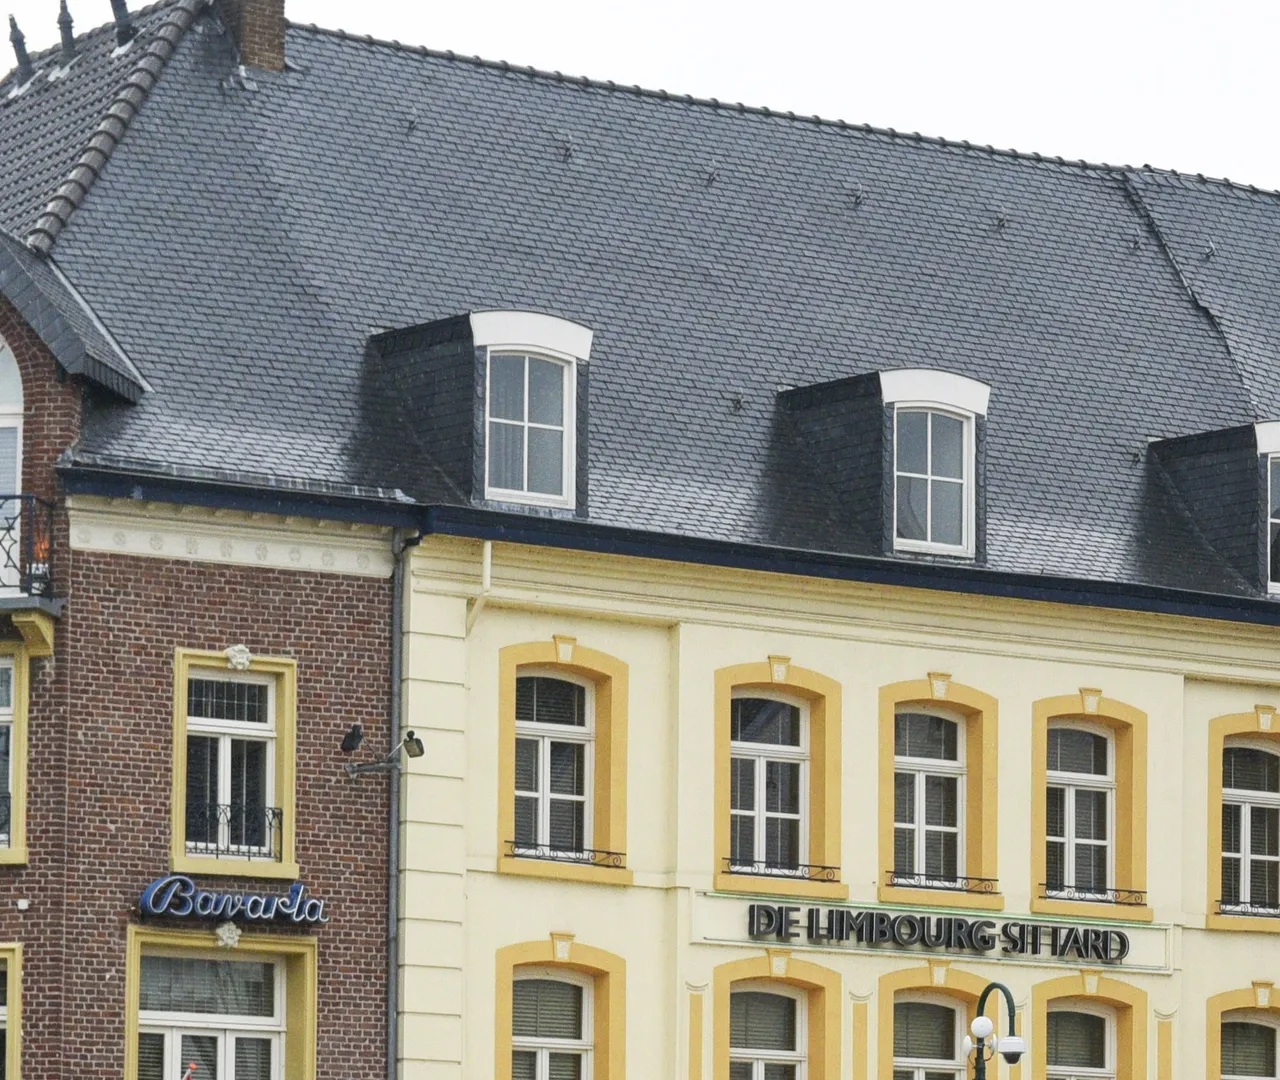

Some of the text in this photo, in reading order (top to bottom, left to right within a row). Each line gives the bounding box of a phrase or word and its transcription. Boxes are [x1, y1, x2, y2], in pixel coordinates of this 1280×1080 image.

[140, 875, 329, 922] Bavaria
[749, 904, 1130, 962] DE LIMBOURG SITTARD
